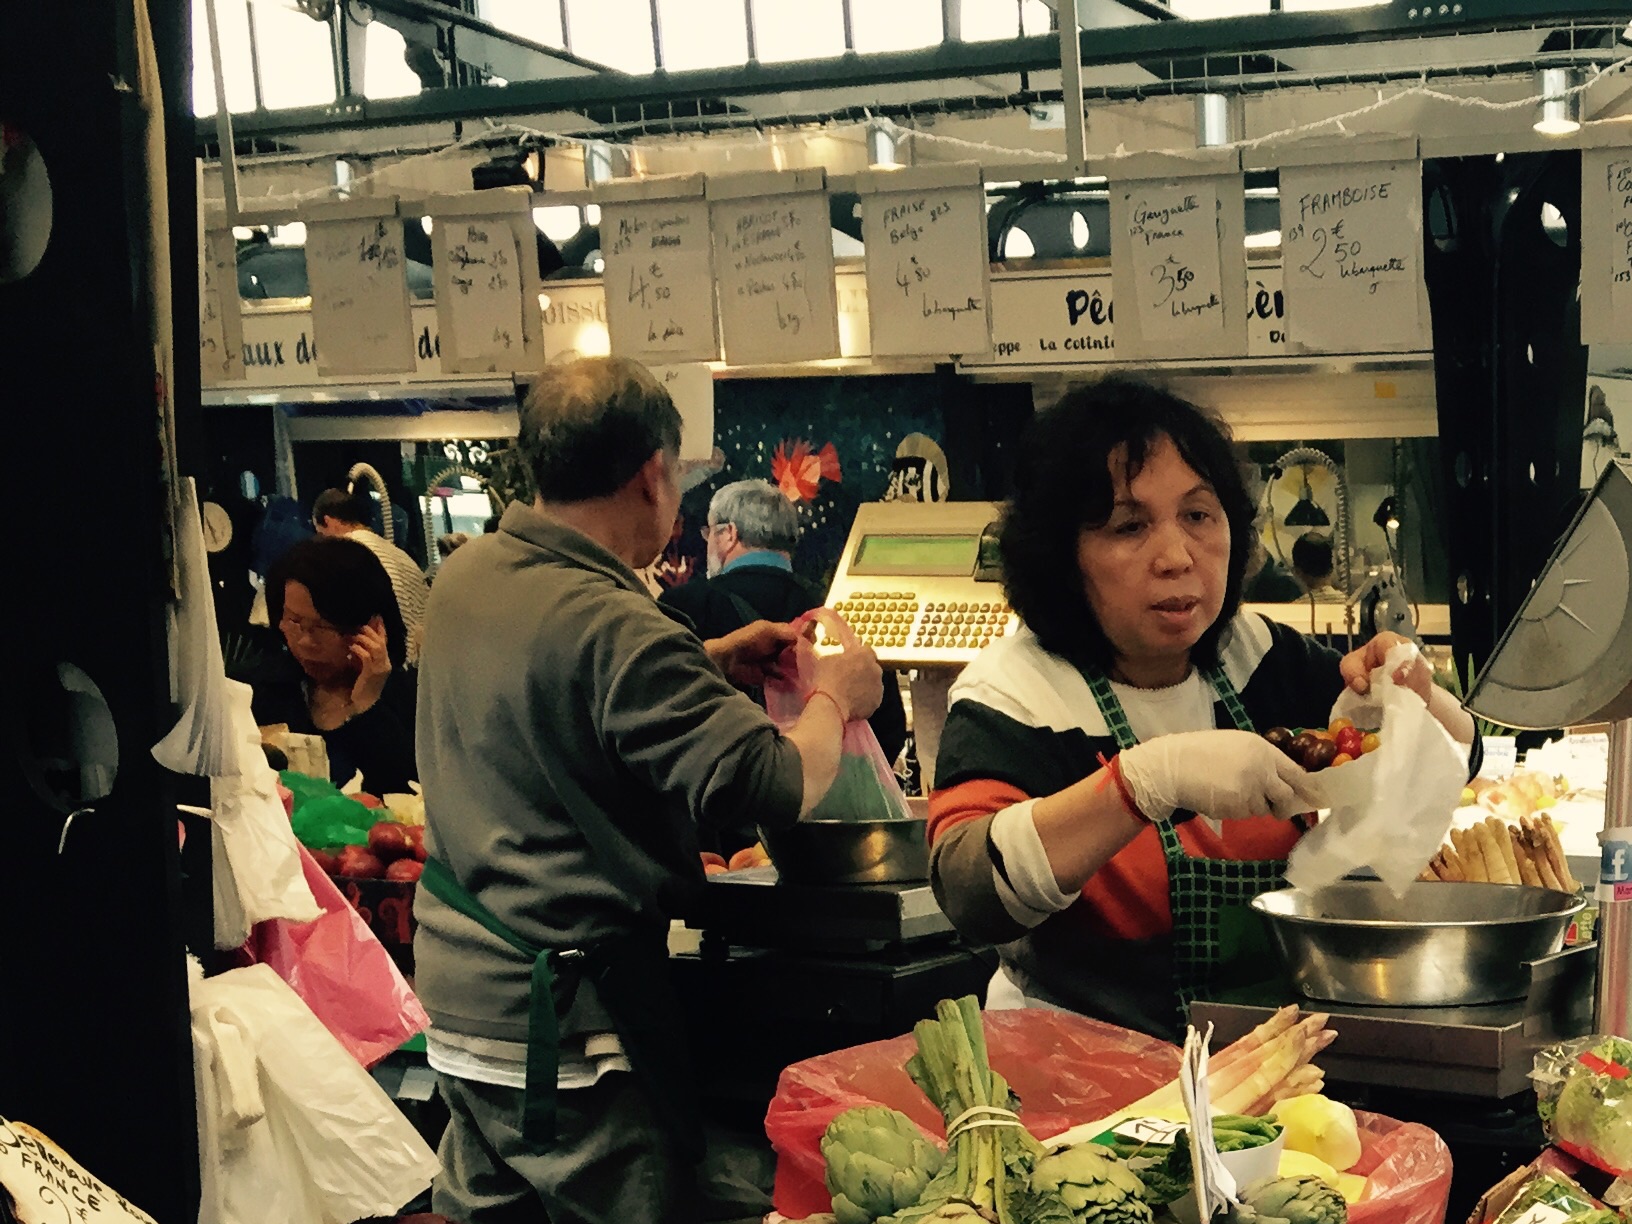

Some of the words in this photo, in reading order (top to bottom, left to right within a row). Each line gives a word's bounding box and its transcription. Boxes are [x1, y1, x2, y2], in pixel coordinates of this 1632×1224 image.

[882, 199, 926, 229] FRAISE
[1299, 182, 1392, 222] FRAMBOISE
[20, 1151, 102, 1213] FRANCE
